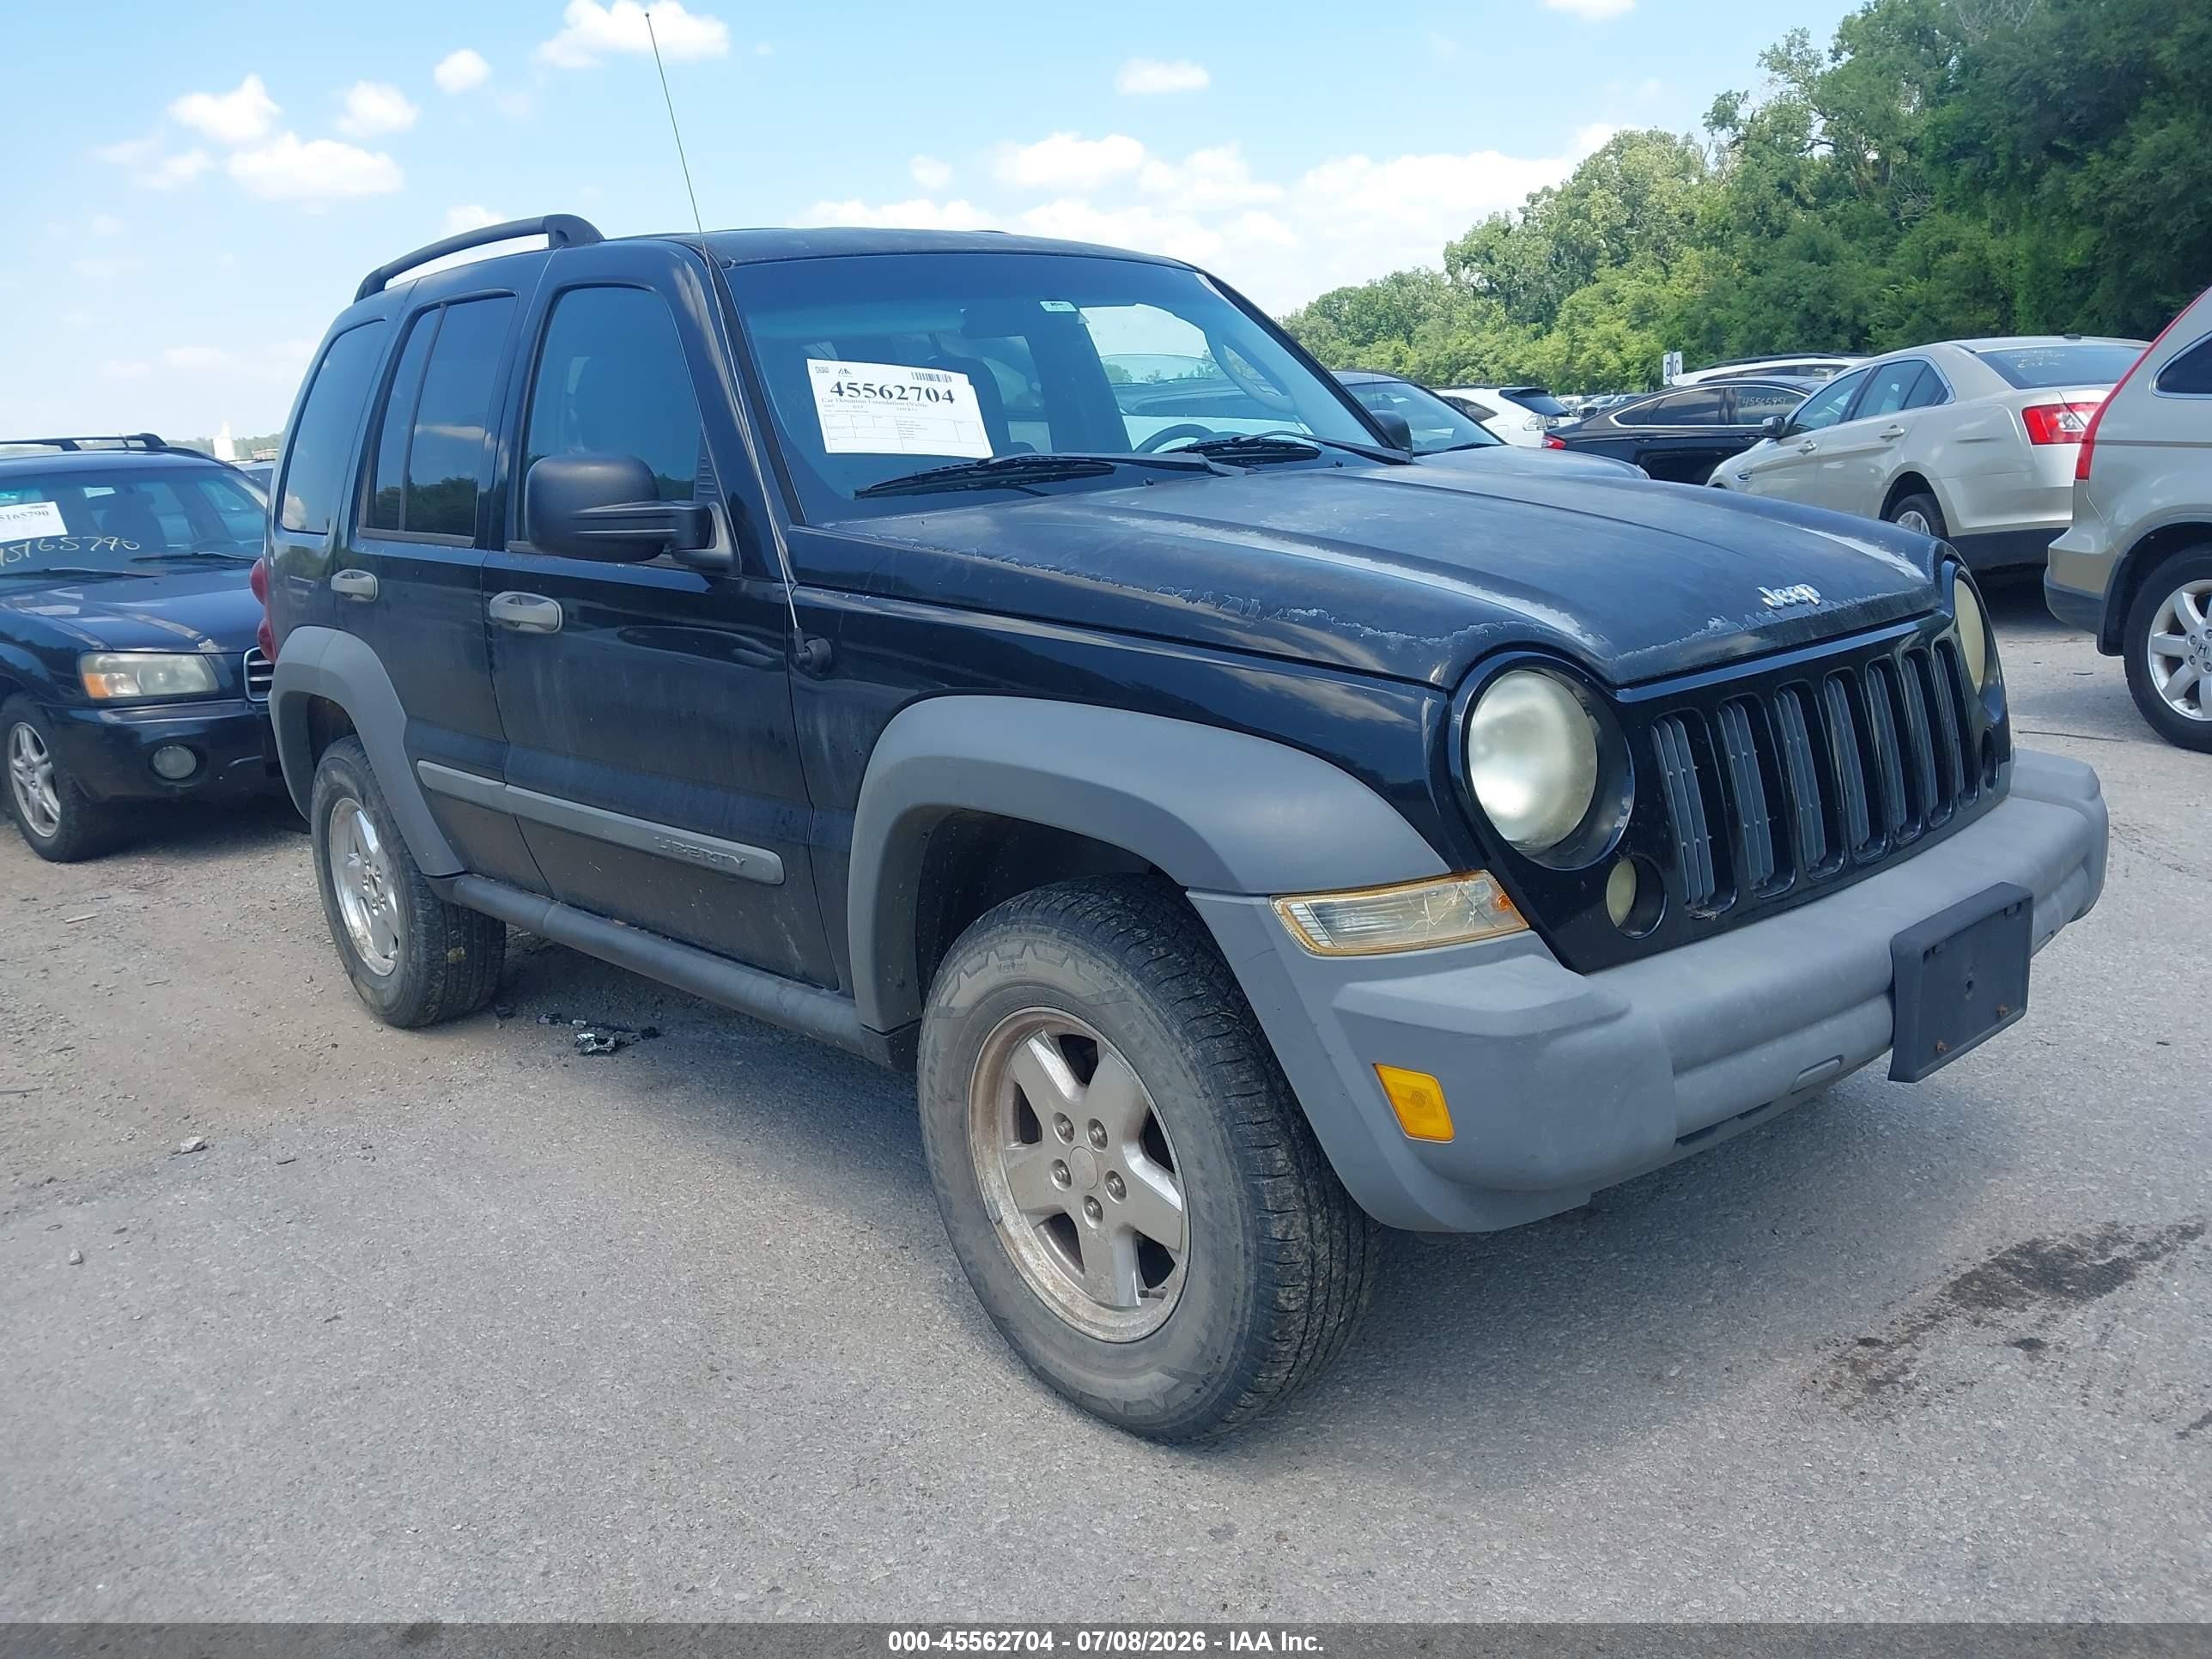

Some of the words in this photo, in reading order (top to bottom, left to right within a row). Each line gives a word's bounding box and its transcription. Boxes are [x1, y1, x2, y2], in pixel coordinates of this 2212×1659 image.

[1674, 359, 1680, 376] C
[830, 380, 956, 404] 45562704
[1757, 583, 1821, 609] Jeep
[653, 836, 747, 866] LIBERTY
